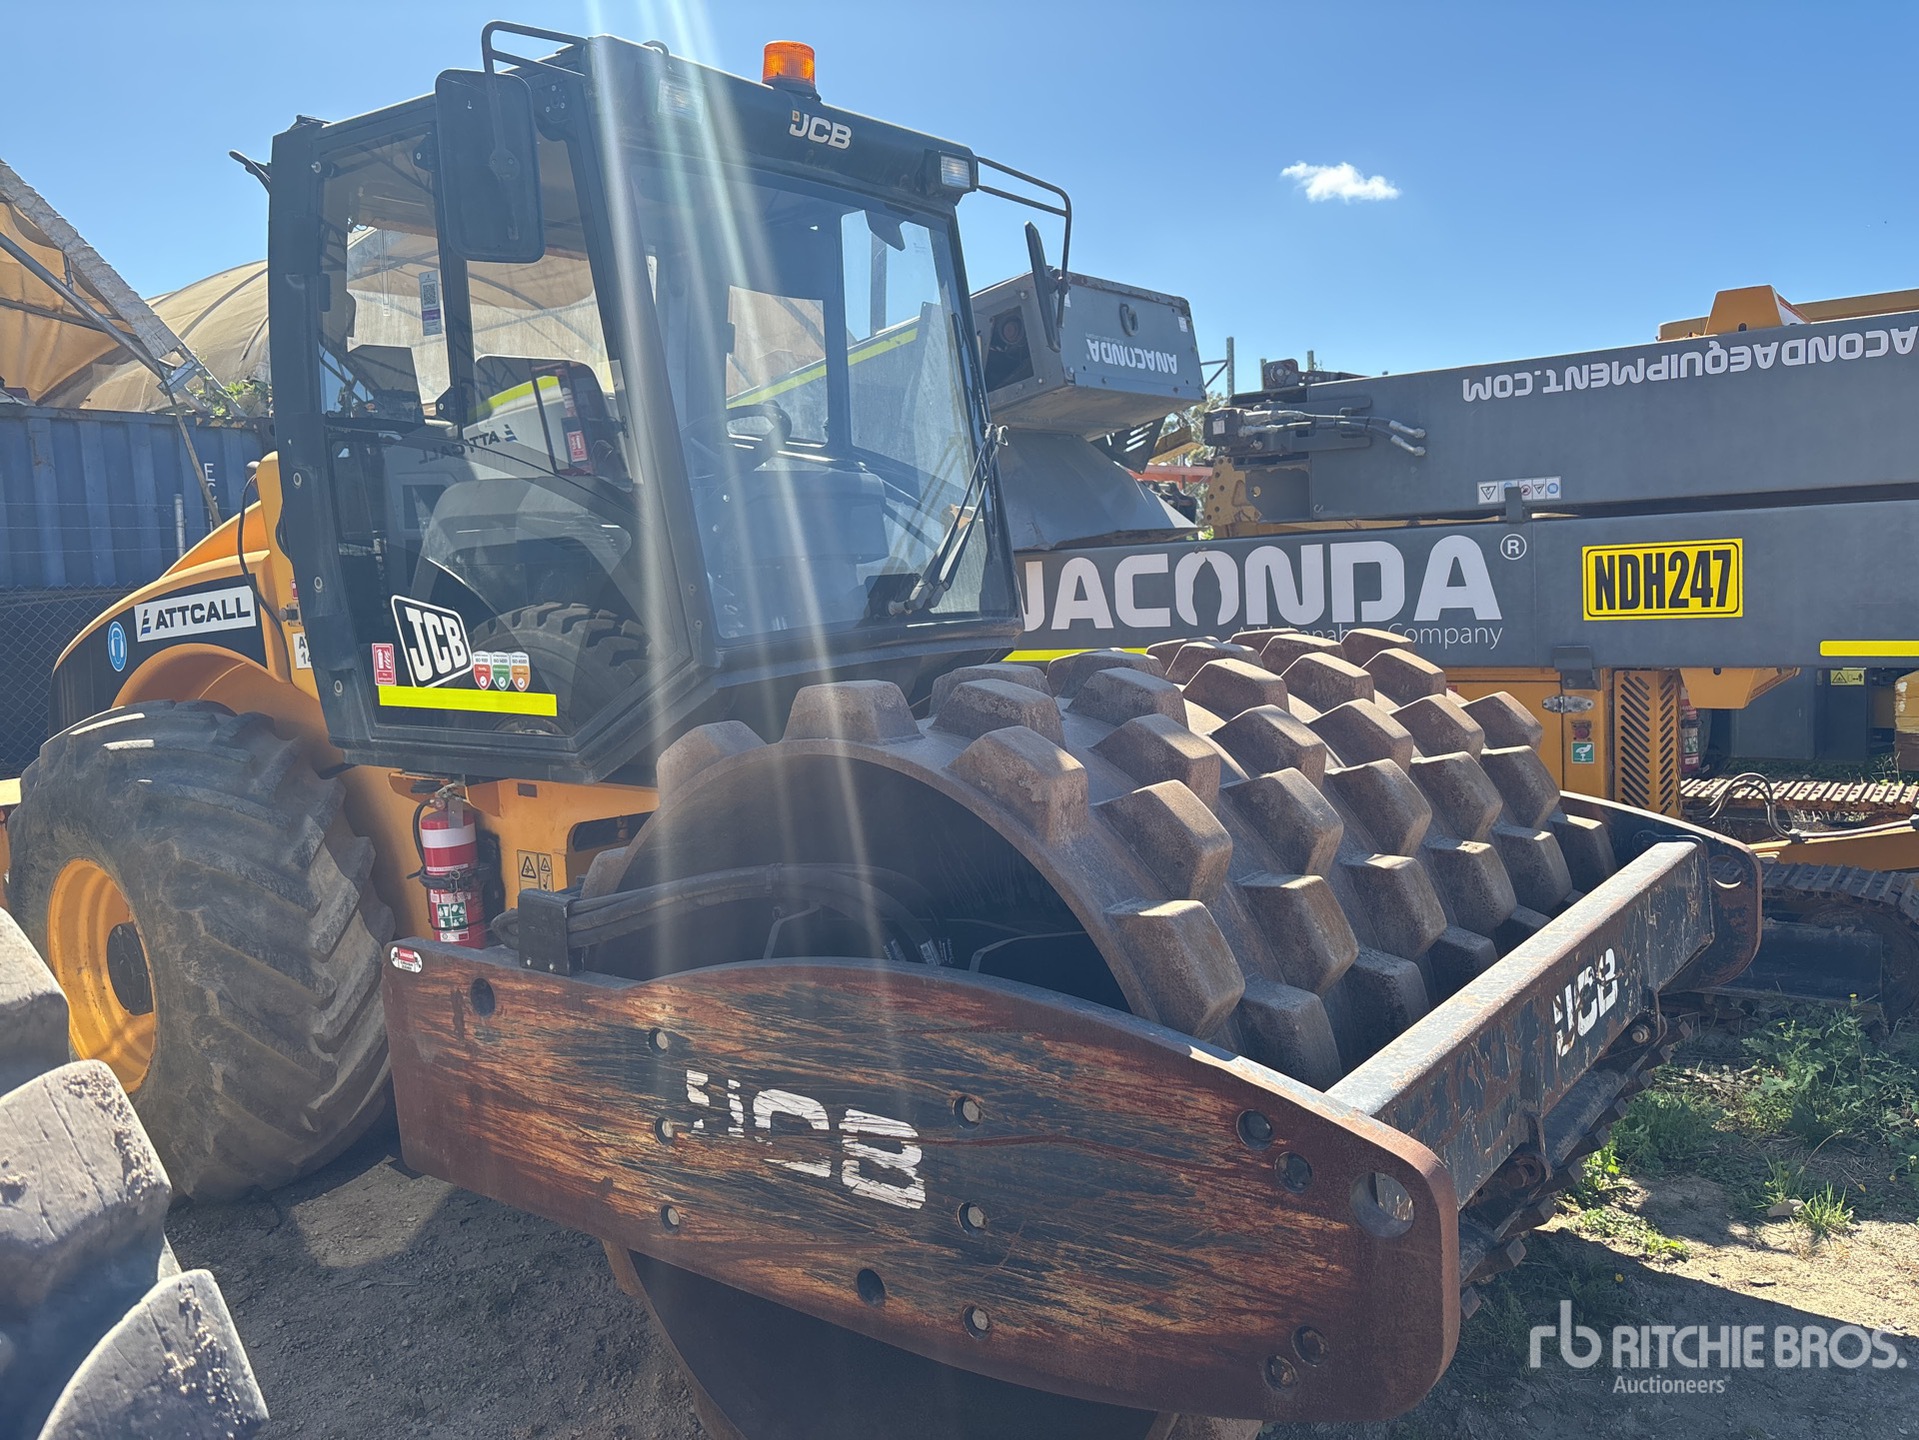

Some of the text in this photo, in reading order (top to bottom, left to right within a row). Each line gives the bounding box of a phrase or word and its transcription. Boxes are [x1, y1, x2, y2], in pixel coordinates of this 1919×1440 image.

[789, 110, 852, 149] JCB
[1086, 339, 1178, 375] ANACONDA
[1594, 549, 1732, 611] NDH247
[155, 597, 251, 630] ATTCALL
[404, 606, 468, 682] JCB
